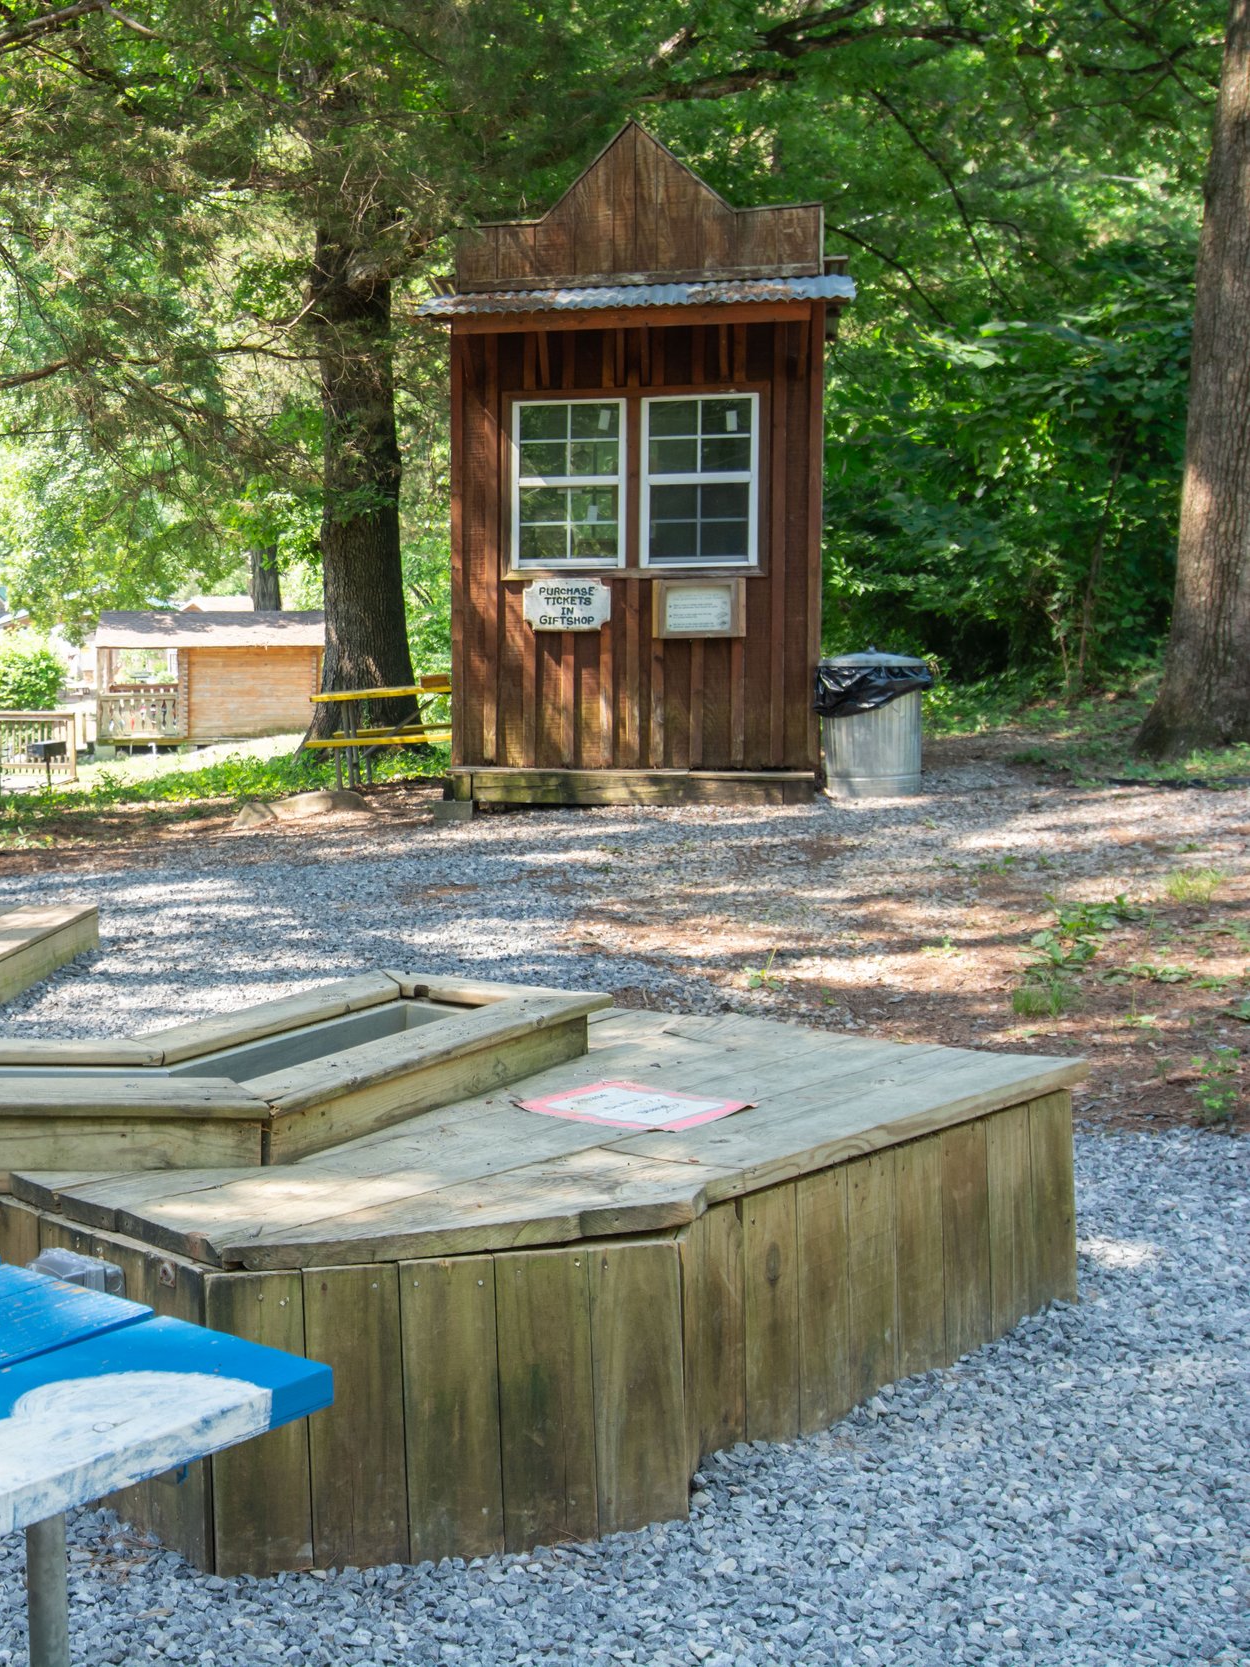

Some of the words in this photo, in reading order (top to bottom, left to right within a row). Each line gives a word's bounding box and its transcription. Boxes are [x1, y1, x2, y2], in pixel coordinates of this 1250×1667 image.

[539, 586, 596, 596] PURCHASE
[544, 596, 592, 606] TICKETS
[561, 606, 575, 616] IN
[539, 615, 595, 626] GIFTSHOP
